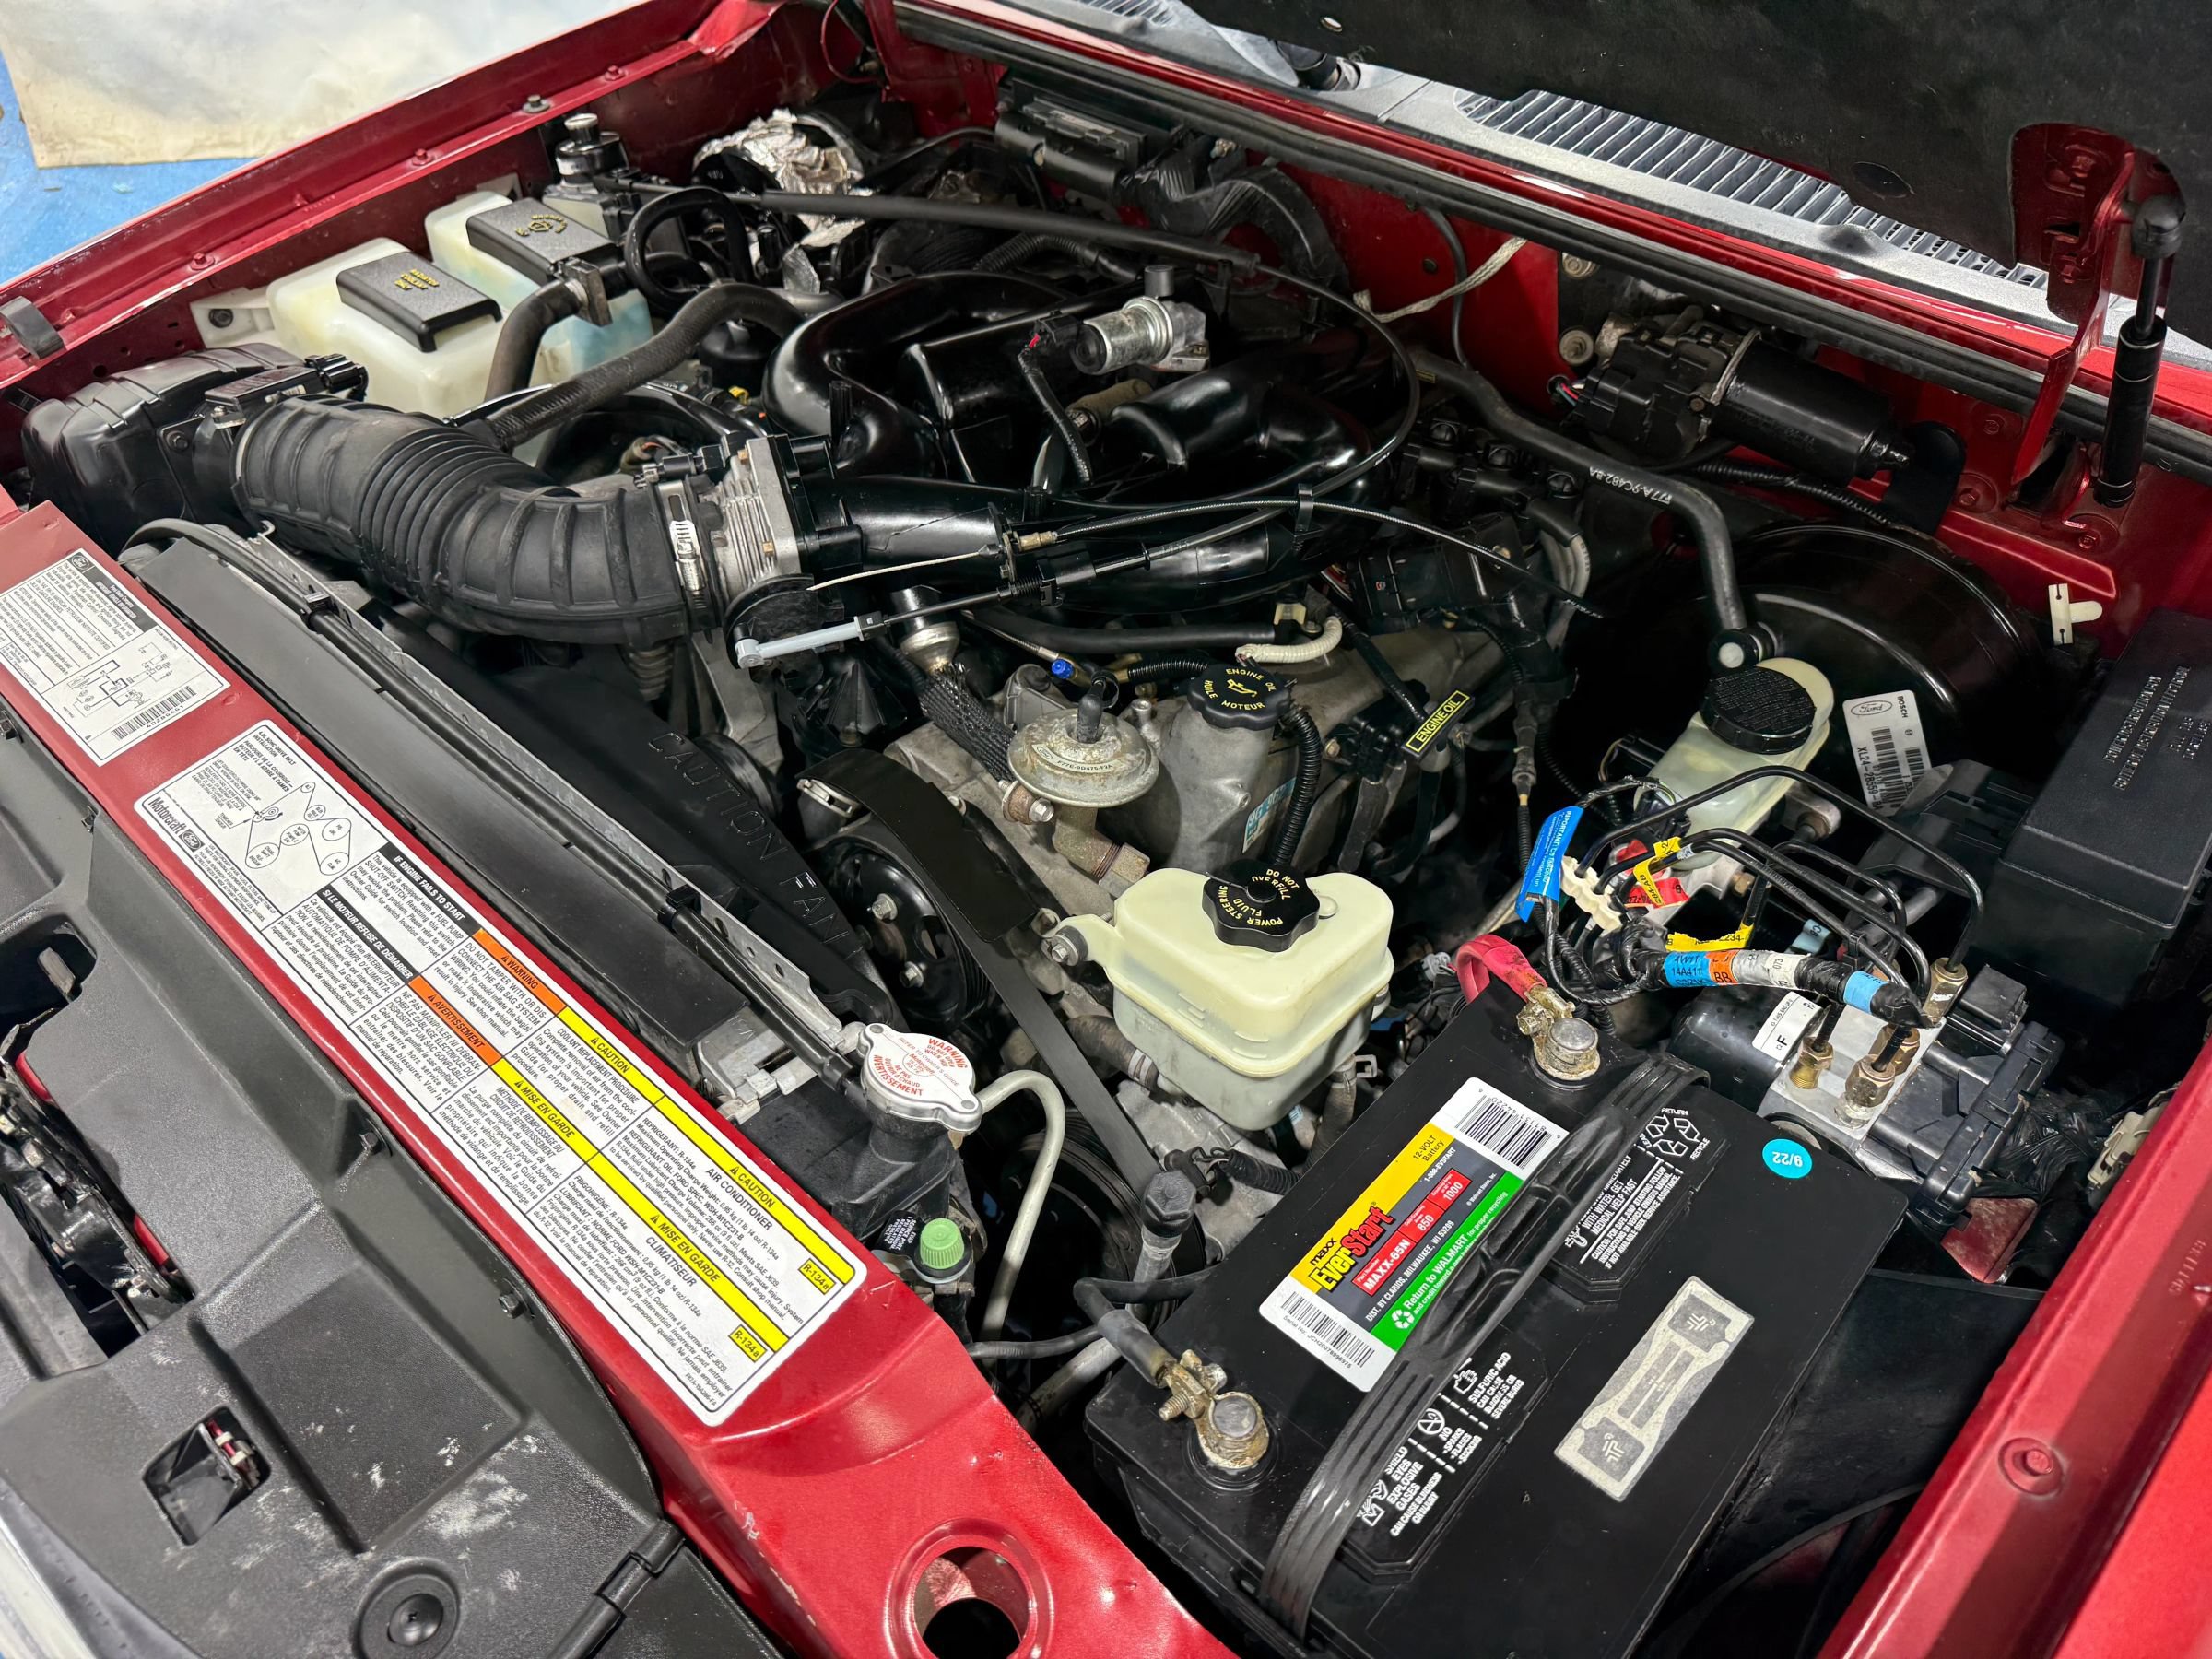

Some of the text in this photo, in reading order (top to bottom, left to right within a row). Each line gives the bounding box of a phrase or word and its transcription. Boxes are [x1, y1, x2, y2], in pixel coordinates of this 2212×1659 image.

[1204, 679, 1218, 699] HUILE
[1226, 668, 1277, 692] ENGINE OIL
[1221, 700, 1265, 711] MOTEUR
[1416, 700, 1461, 743] ENGINE OIL
[1897, 695, 1909, 718] BOSCH
[147, 796, 186, 834] Motorcraft
[648, 732, 787, 860] CAUTION
[398, 860, 423, 882] ENGINE
[418, 879, 438, 896] FAILS
[434, 893, 446, 904] TO
[442, 901, 465, 920] START
[1252, 876, 1291, 900] OVERFILL
[1266, 868, 1300, 889] DO NOT
[1218, 885, 1283, 926] POWER STEERING
[1233, 898, 1263, 917] FLUID
[322, 888, 413, 979] SI LE MOTEUR REFUSE DE DÉMARRER
[449, 953, 533, 1032] WIRING. You could inflate the bag(s)
[457, 947, 541, 1026] CONNECT THE AIR BAG SYSTEM
[465, 942, 547, 1018] DO NOT TAMPER WITH OR DIS-
[506, 959, 538, 989] WARNING
[1714, 971, 1732, 983] BB
[433, 966, 509, 1037] result in injury. See shop manual.
[448, 966, 463, 981] make
[466, 982, 495, 1012] inoperative
[494, 1010, 511, 1027] which
[509, 1026, 524, 1039] may
[432, 1001, 485, 1047] AVERTISSEMENT
[1777, 1034, 1788, 1047] F
[510, 1053, 538, 1079] procedure.
[542, 1028, 568, 1052] Complete
[565, 1050, 589, 1071] removal
[591, 1075, 601, 1083] air
[598, 1080, 614, 1095] from
[612, 1092, 623, 1103] the
[620, 1102, 636, 1115] cool-
[556, 1028, 640, 1103] COOLANT REPLACEMENT PROCEDURE
[596, 1042, 629, 1073] CAUTION
[928, 1038, 968, 1069] WARNING
[520, 1046, 615, 1136] Guide for proper drain and refill
[527, 1041, 552, 1065] operation
[556, 1069, 572, 1082] your
[571, 1081, 590, 1101] vehicle.
[590, 1099, 602, 1112] See
[601, 1110, 621, 1129] Owner
[535, 1033, 629, 1123] ing system is important for proper
[874, 1054, 924, 1096] AVERTISSEMENT
[520, 1086, 575, 1137] MISE EN GARDE
[1661, 1107, 1688, 1116] RETURN
[1412, 1135, 1436, 1159] 12-VOLT
[1421, 1140, 1444, 1161] Battery
[1423, 1147, 1455, 1182] 1-888-EVSTART
[1689, 1137, 1711, 1160] RECYCLE
[1771, 1149, 1804, 1168] 9/22
[705, 1168, 772, 1230] AIR CONDITIONER
[737, 1172, 775, 1207] CAUTION
[1442, 1182, 1463, 1200] 1000
[1581, 1211, 1599, 1229] WITH
[1609, 1179, 1624, 1193] GET
[1589, 1178, 1637, 1235] MEDICAL HELP FAST
[1606, 1227, 1618, 1240] FOR
[1614, 1216, 1628, 1230] SAFE
[1623, 1204, 1636, 1218] JUMP
[1632, 1182, 1653, 1206] STARTING
[1648, 1165, 1665, 1185] FOLLOW
[1417, 1214, 1434, 1230] 850
[645, 1236, 697, 1287] CLIMATISEUR
[657, 1222, 721, 1282] MISE EN GARDE
[1307, 1203, 1395, 1293] EverStart
[1309, 1237, 1337, 1265] maxx
[1362, 1238, 1410, 1290] MAXX-65N
[1402, 1191, 1508, 1309] Return to WALMART for proper recycling
[803, 1263, 829, 1289] R-134a
[1356, 1258, 1379, 1282] Part Number
[1364, 1306, 1381, 1322] DIST.
[1376, 1297, 1387, 1308] BY
[1382, 1277, 1407, 1300] CLARIOS,
[1403, 1243, 1435, 1277] MILWAUKEE,
[1430, 1234, 1441, 1244] WI
[1413, 1268, 1453, 1314] and credit toward
[733, 1329, 759, 1357] R-134a
[1468, 1352, 1511, 1404] SULFURIC ACID
[1438, 1427, 1453, 1441] NO
[1384, 1446, 1408, 1475] SHIELD
[1391, 1458, 1412, 1482] EYES
[1386, 1461, 1424, 1505] EXPLOSIVE
[1395, 1482, 1420, 1511] GASES
